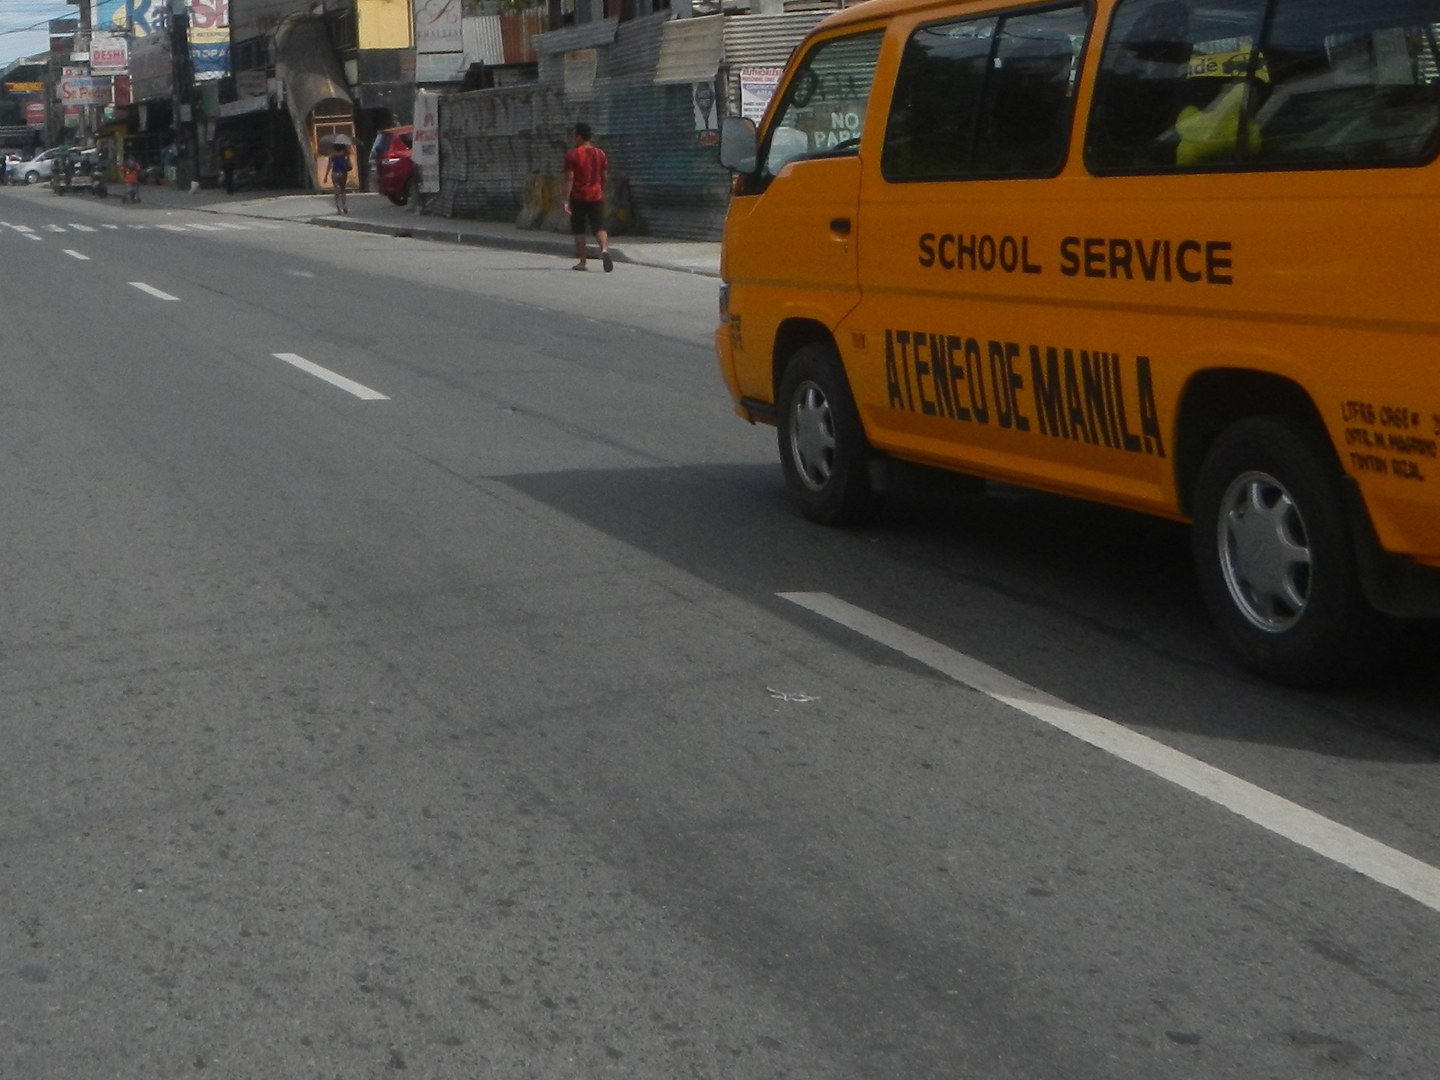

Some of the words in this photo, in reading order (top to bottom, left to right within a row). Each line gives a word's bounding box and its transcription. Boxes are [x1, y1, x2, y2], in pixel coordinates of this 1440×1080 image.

[831, 111, 859, 129] NO
[918, 232, 1042, 274] SCHOOL
[1060, 236, 1233, 285] SERVICE
[885, 329, 989, 425] ATENEO
[988, 340, 1031, 432] DE
[1029, 344, 1166, 458] MANILA
